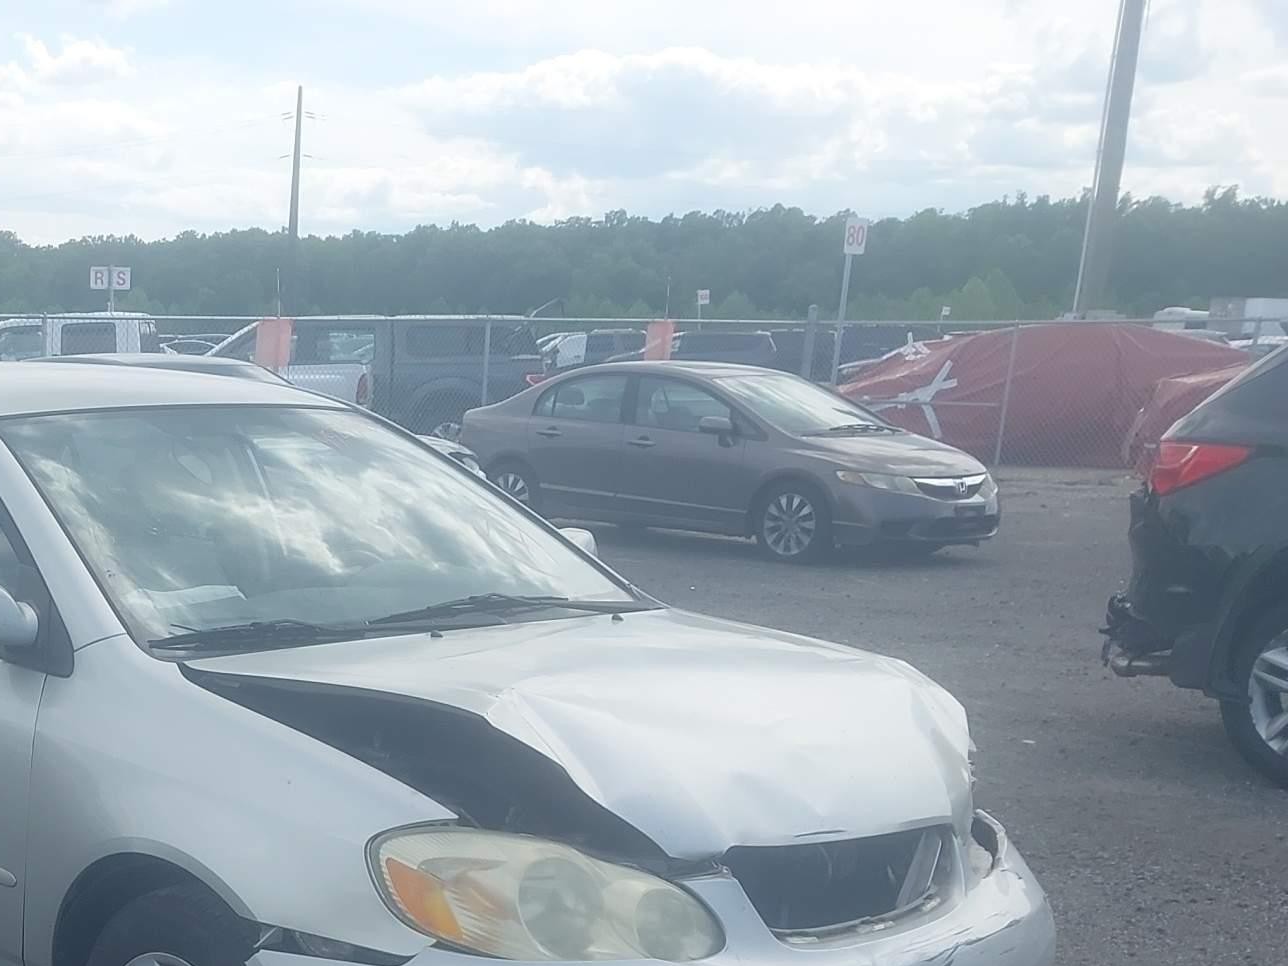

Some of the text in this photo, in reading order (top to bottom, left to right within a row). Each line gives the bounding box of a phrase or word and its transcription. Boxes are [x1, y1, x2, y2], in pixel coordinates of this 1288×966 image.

[846, 224, 865, 247] 80
[94, 270, 105, 287] R
[115, 270, 127, 287] S
